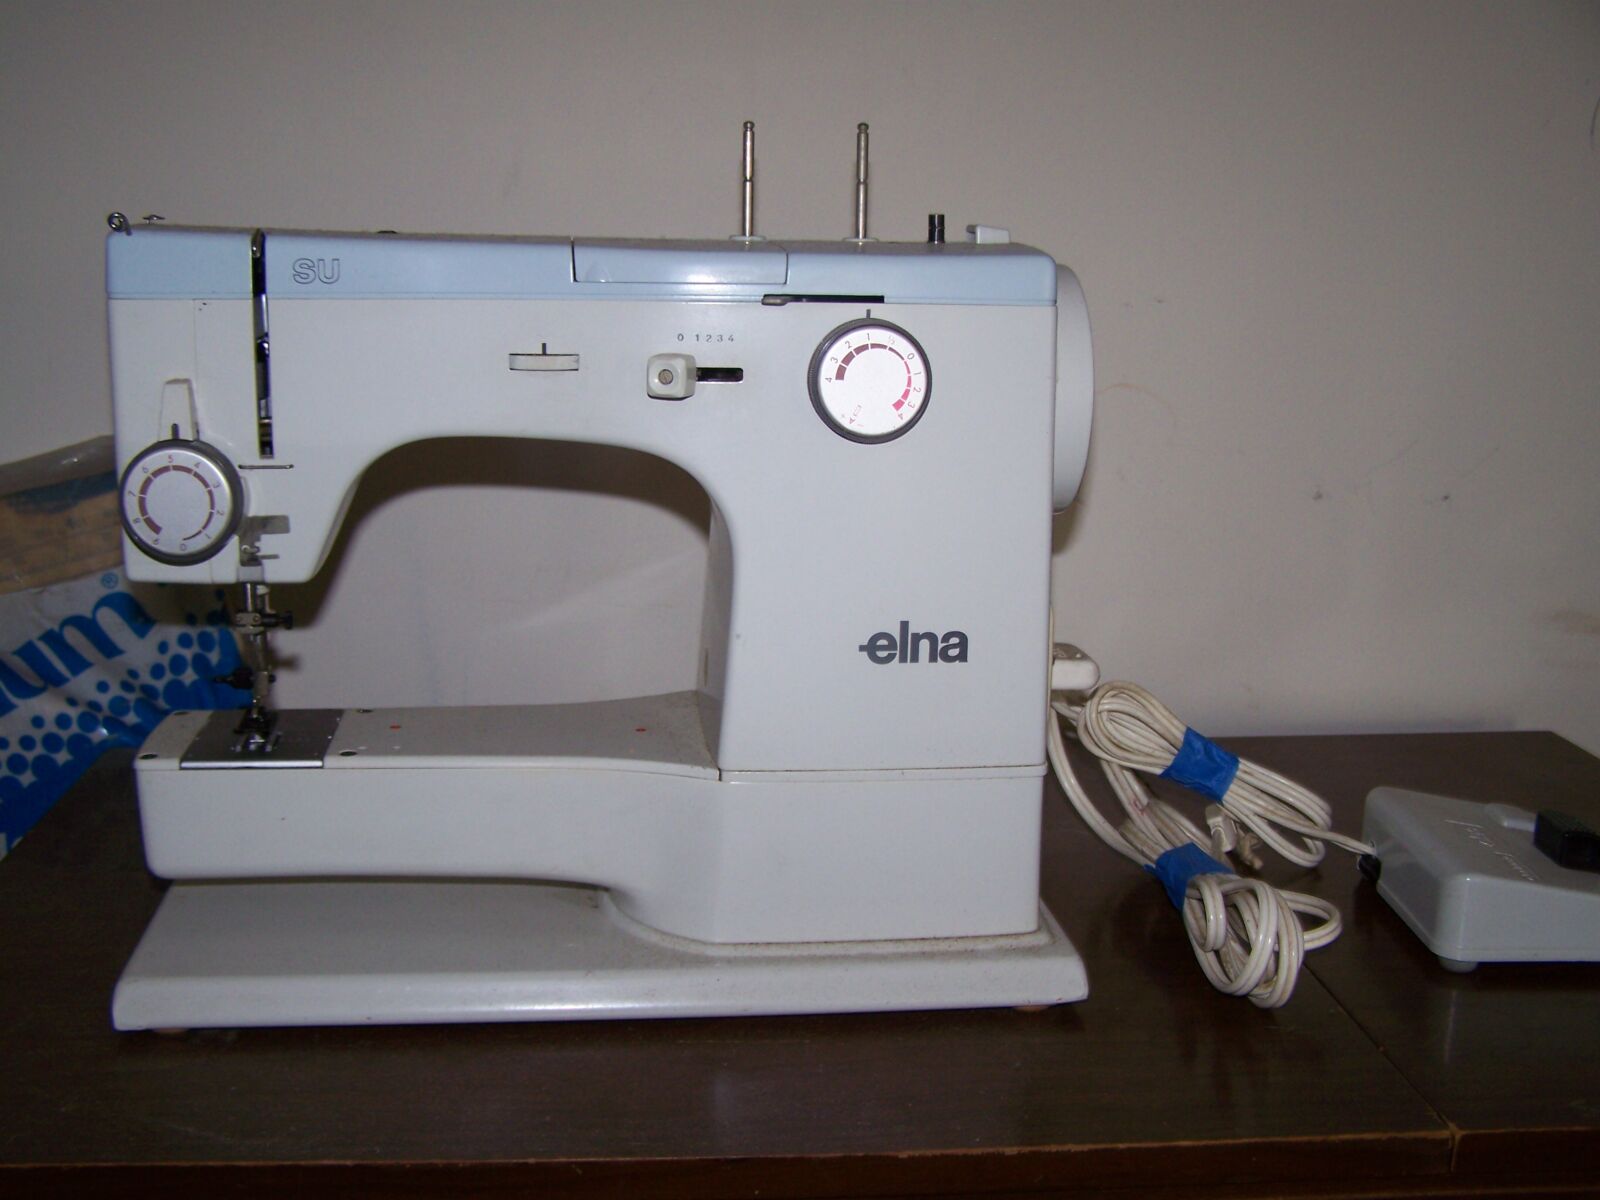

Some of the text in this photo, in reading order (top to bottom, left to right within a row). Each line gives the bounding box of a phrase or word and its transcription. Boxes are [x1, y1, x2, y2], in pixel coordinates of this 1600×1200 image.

[293, 257, 340, 285] SU
[677, 333, 684, 342] 0
[706, 334, 712, 342] 2
[717, 334, 723, 342] 3
[728, 334, 734, 342] 4
[830, 356, 838, 364] 3
[845, 340, 853, 349] 2
[907, 352, 915, 360] 0
[168, 454, 174, 464] 5
[858, 620, 969, 665] elna
